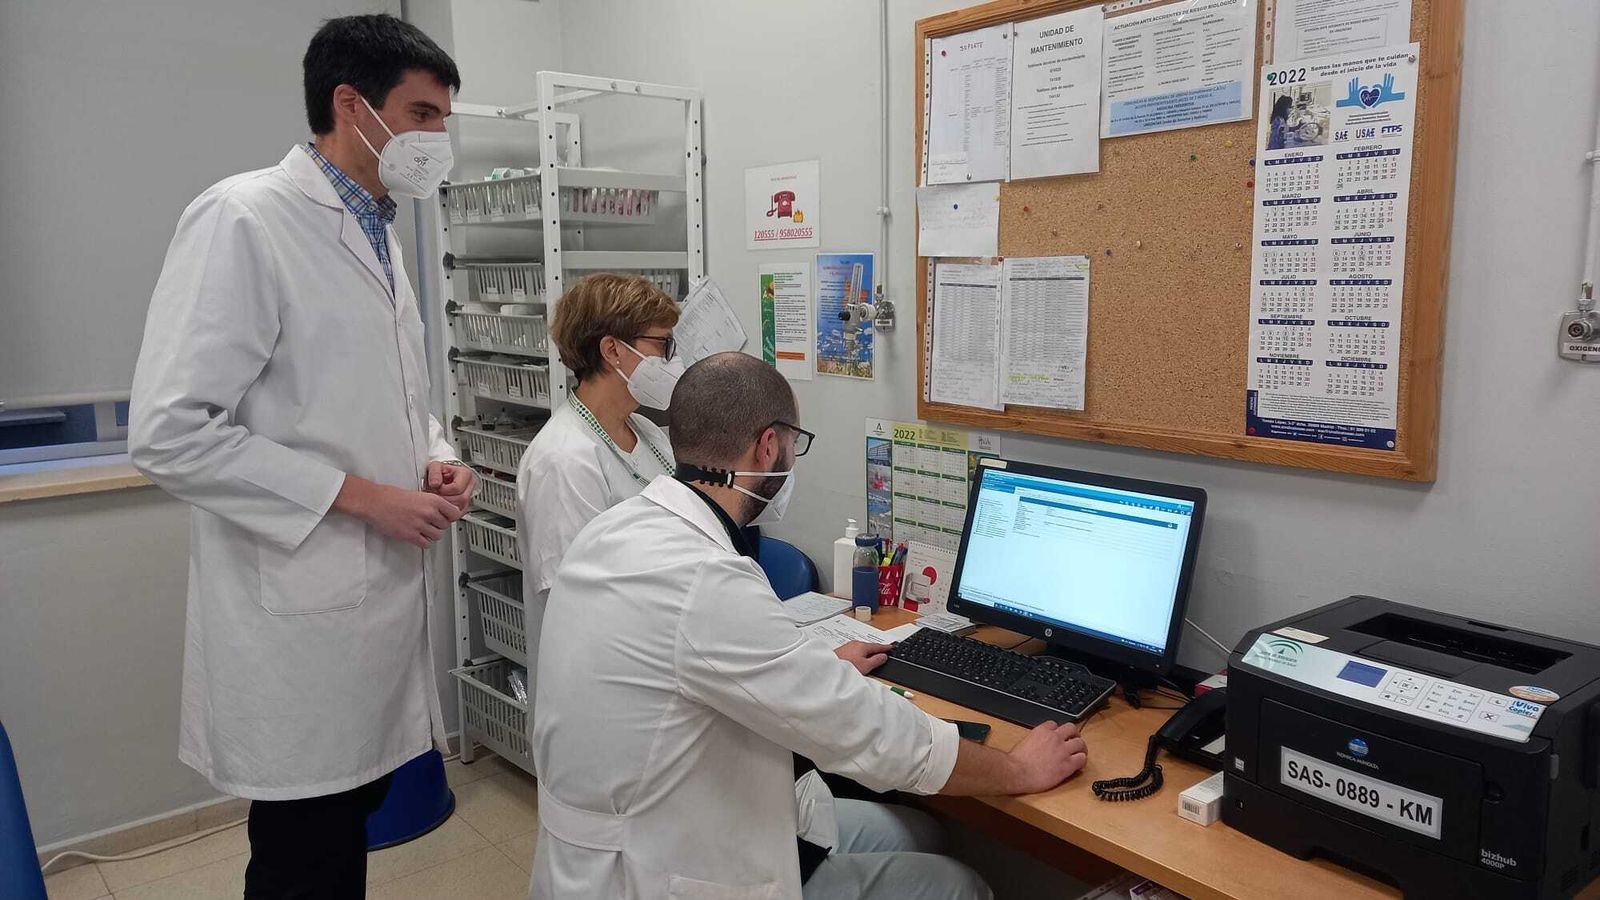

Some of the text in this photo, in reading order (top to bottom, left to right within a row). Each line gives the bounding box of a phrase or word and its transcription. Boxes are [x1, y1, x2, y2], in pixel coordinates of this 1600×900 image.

[1153, 12, 1182, 22] ACCIDENTES
[1190, 6, 1207, 14] RIESGO
[1040, 25, 1074, 38] UNIDAD DE
[1031, 38, 1083, 54] MANTENIMIENTO
[1269, 68, 1306, 86] 2022
[1335, 125, 1403, 141] SAE USAE FTPS
[754, 230, 774, 239] 120555
[779, 227, 812, 238] 958020555
[894, 429, 916, 440] 2022
[1509, 706, 1533, 715] Copier
[1288, 760, 1330, 788] SAS-
[1336, 778, 1379, 808] 0889
[1399, 798, 1432, 826] KM
[1481, 848, 1517, 867] bizhub
[1481, 858, 1505, 869] 4000P
